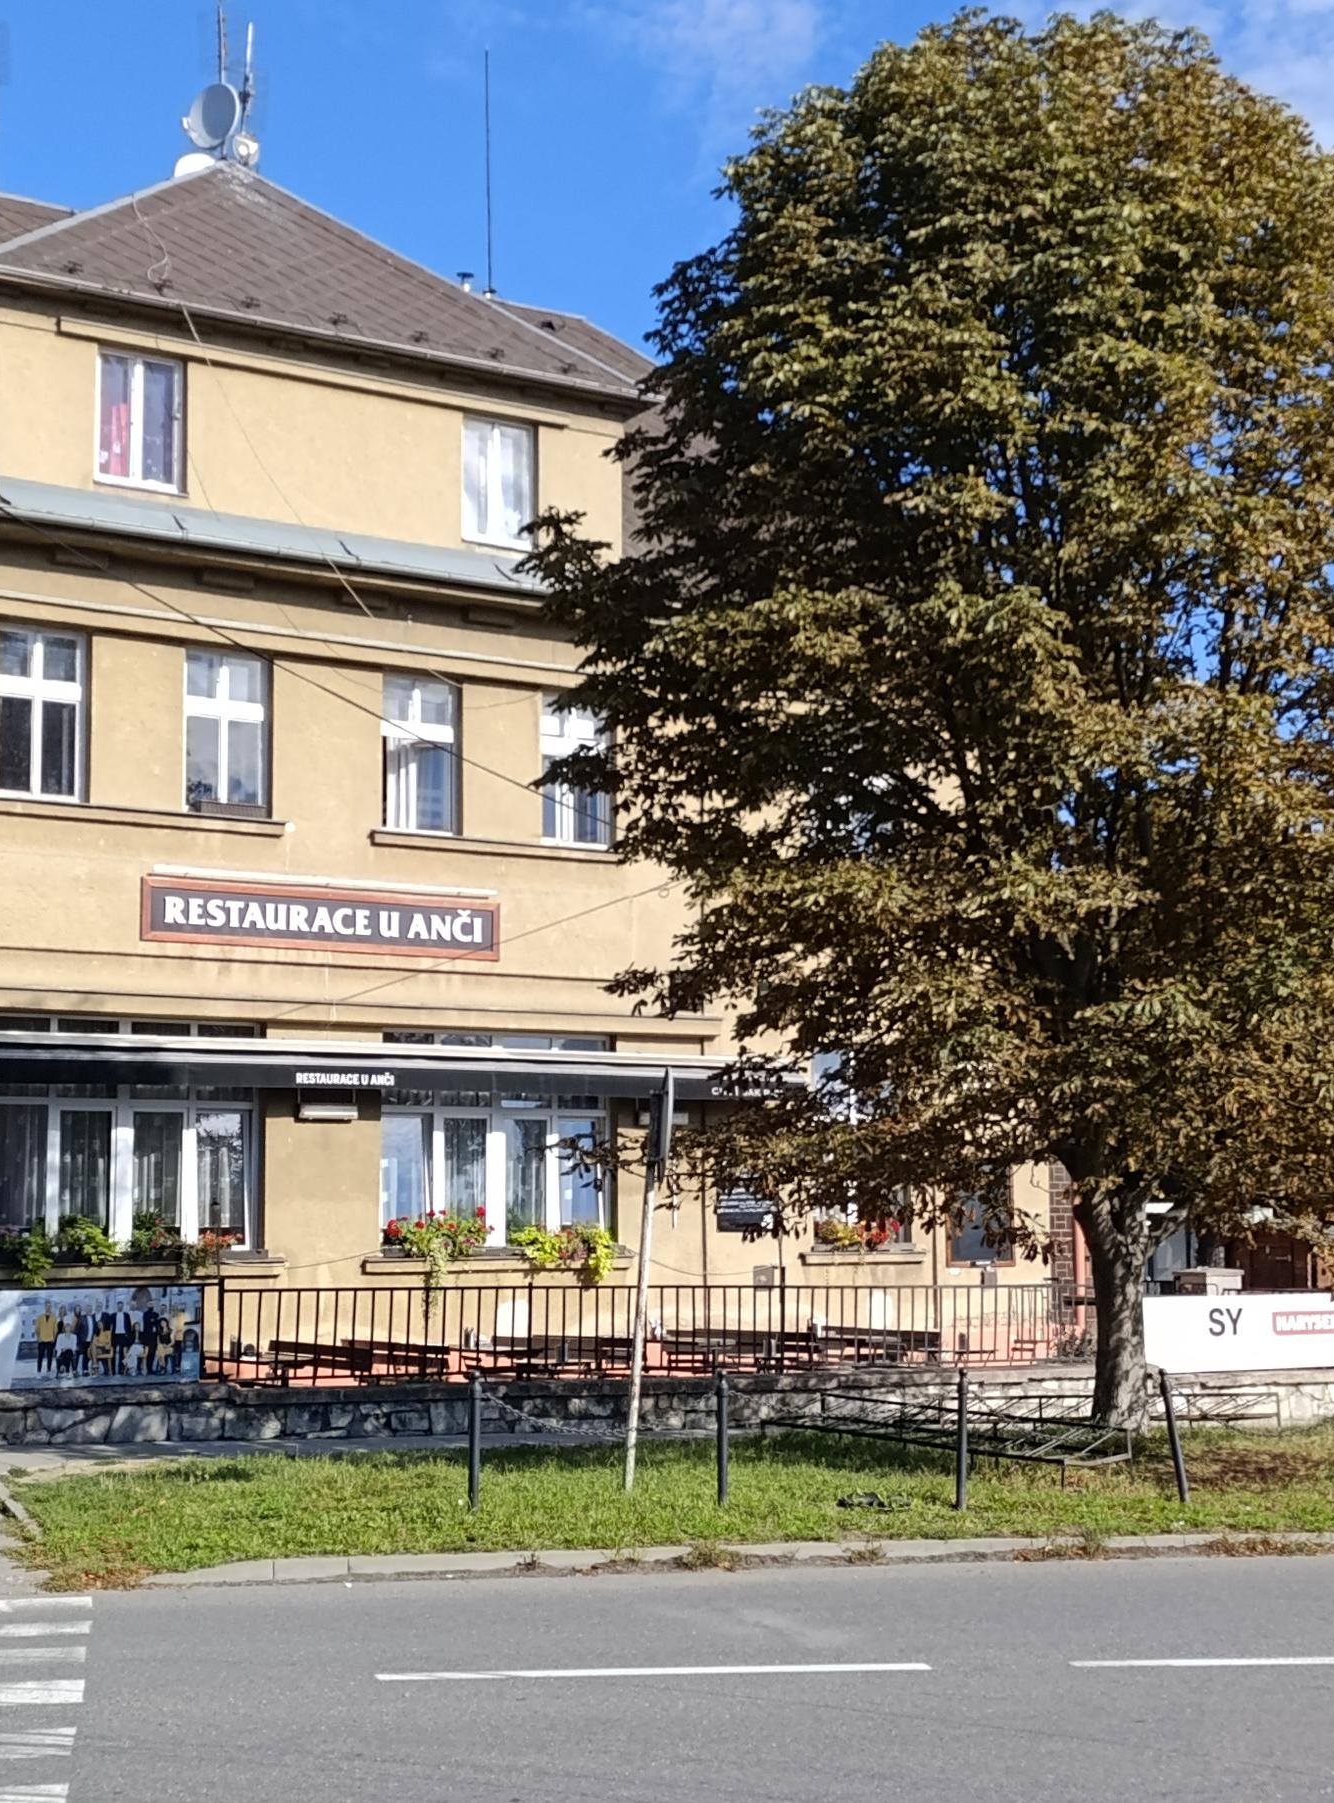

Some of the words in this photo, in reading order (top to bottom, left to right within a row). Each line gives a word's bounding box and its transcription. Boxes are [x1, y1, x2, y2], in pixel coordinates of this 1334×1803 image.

[164, 896, 372, 937] RESTAURACE
[379, 911, 400, 938] U
[407, 910, 484, 944] ANČI
[295, 1072, 360, 1086] RESTAURACE
[361, 1074, 369, 1086] U
[370, 1072, 395, 1087] ANČI
[1208, 1307, 1243, 1337] SY
